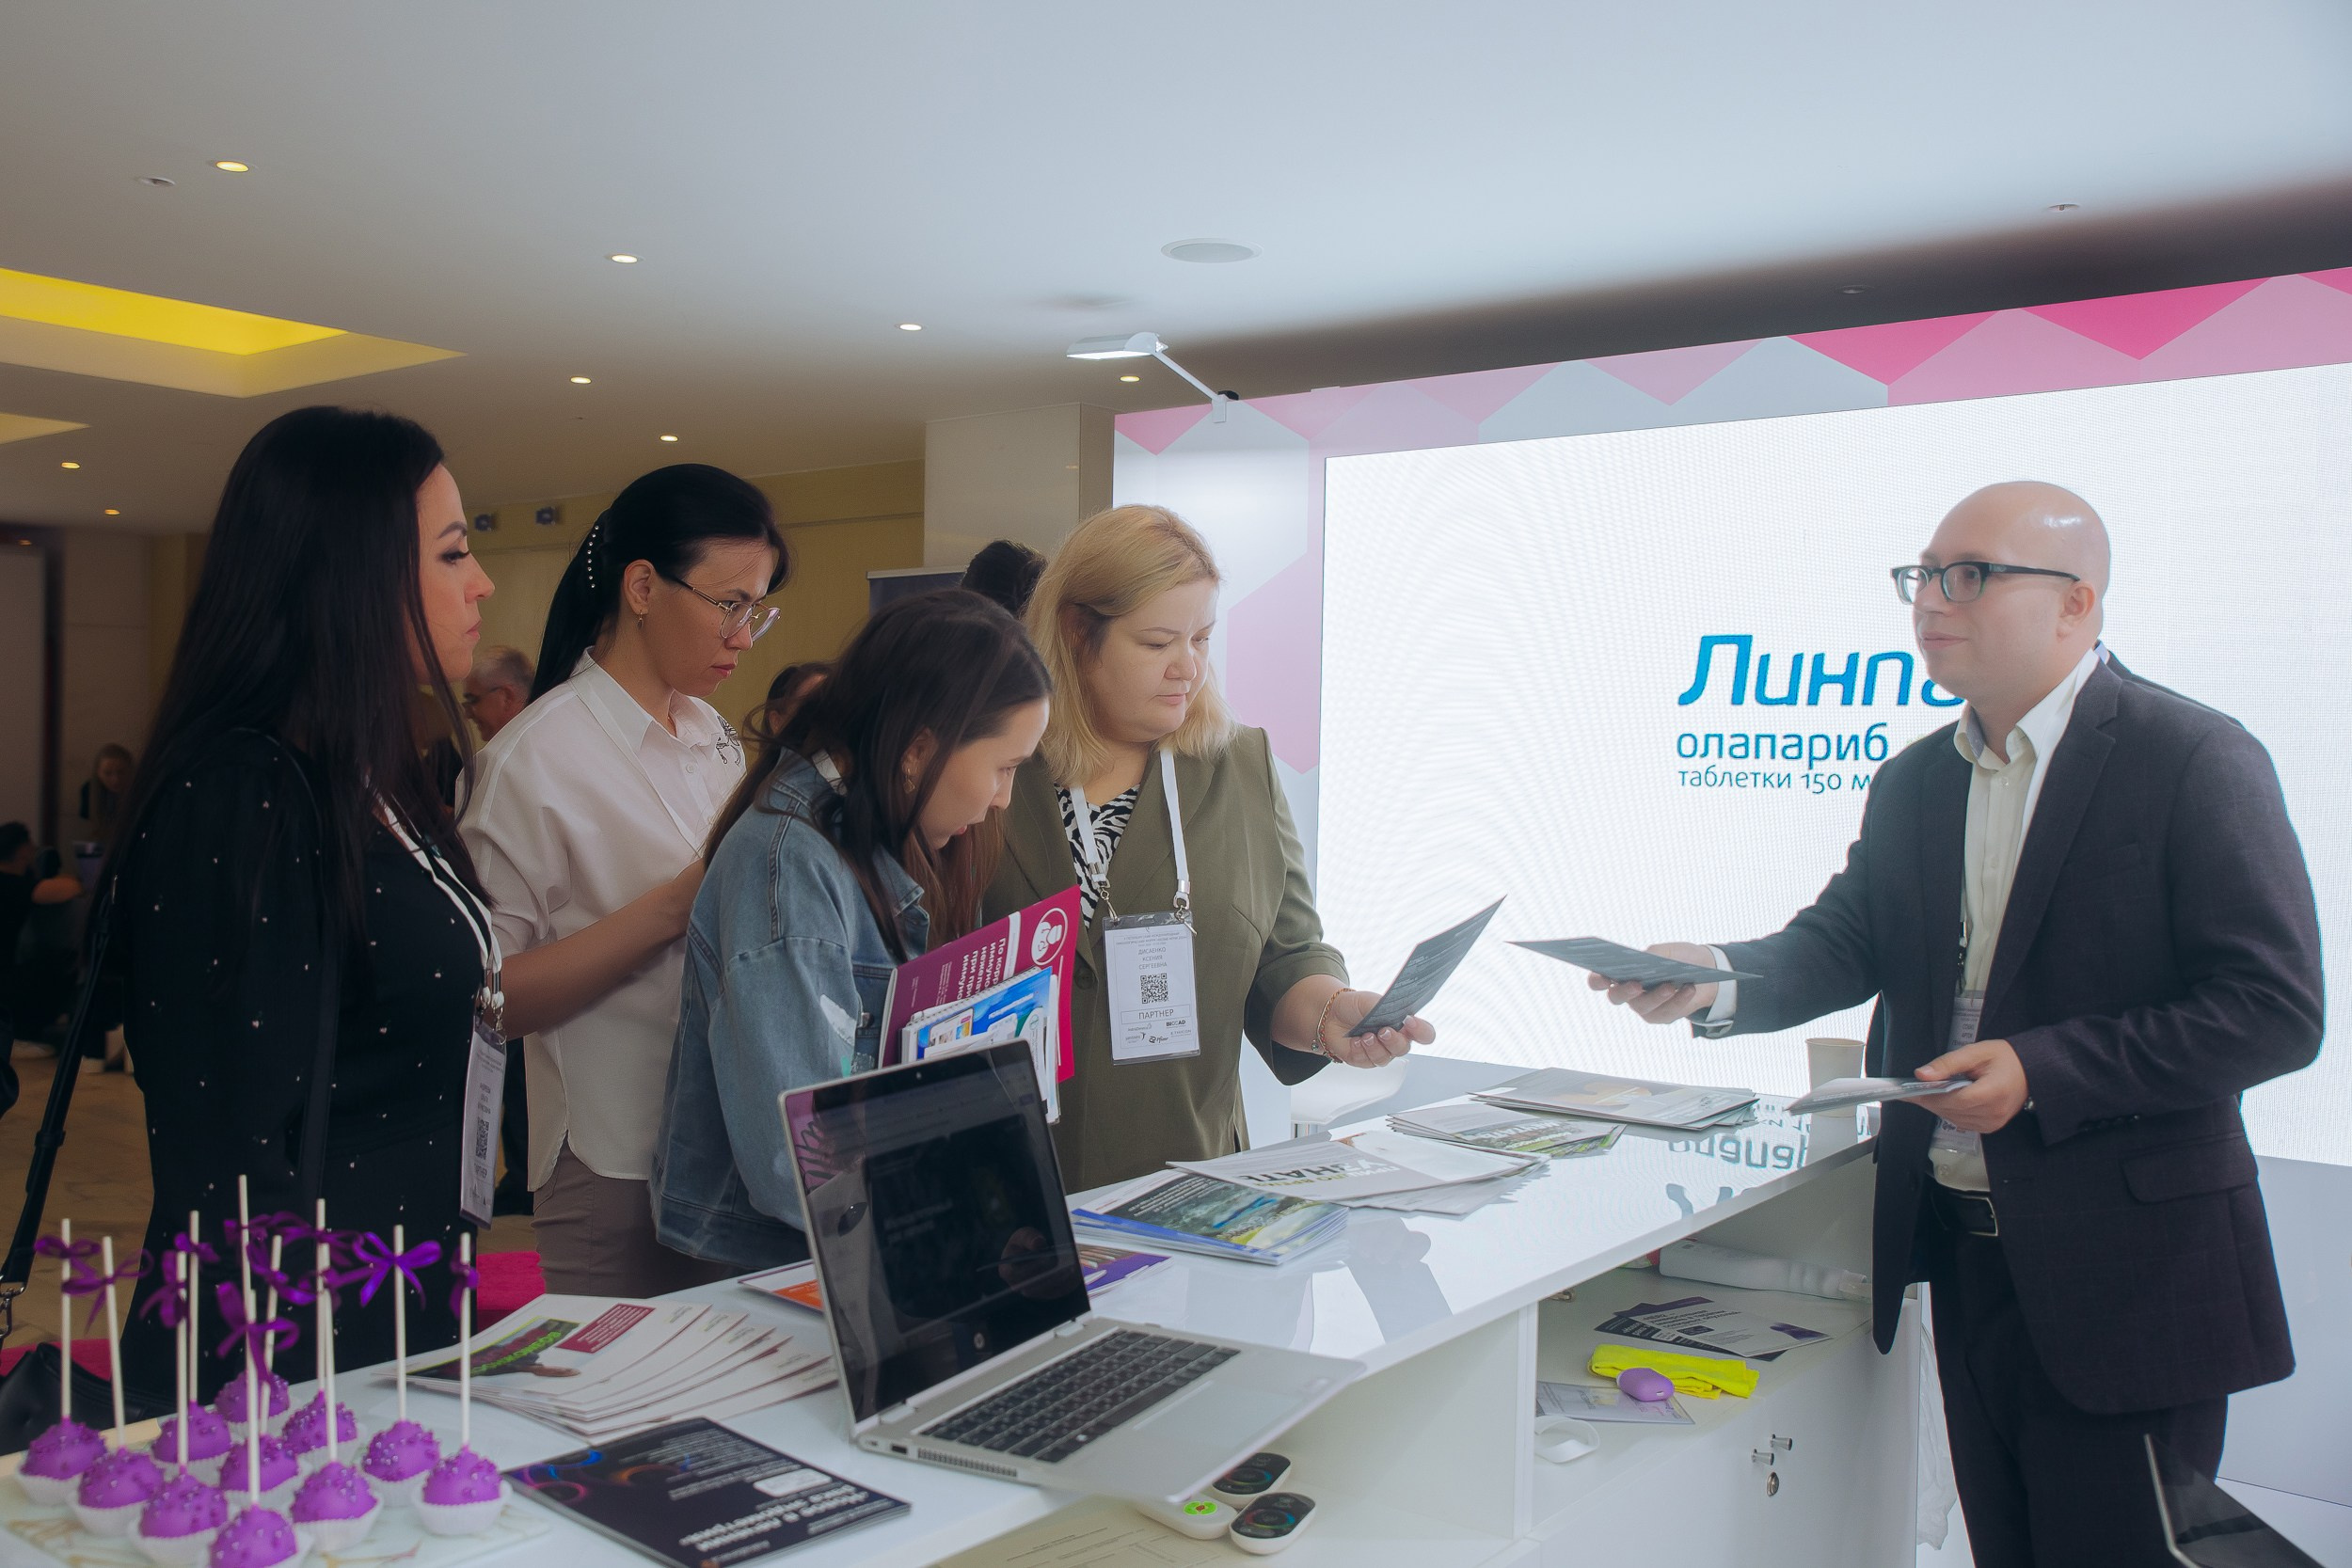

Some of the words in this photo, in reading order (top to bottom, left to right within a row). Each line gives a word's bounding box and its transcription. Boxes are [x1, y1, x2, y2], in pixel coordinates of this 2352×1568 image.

[1677, 722, 1888, 769] олапариб
[1678, 765, 1792, 789] таблетки
[1801, 773, 1842, 794] 150
[997, 937, 1007, 955] По
[1138, 1008, 1174, 1020] ПАРТНЕР
[1245, 1159, 1388, 1182] УЗНАТЬ
